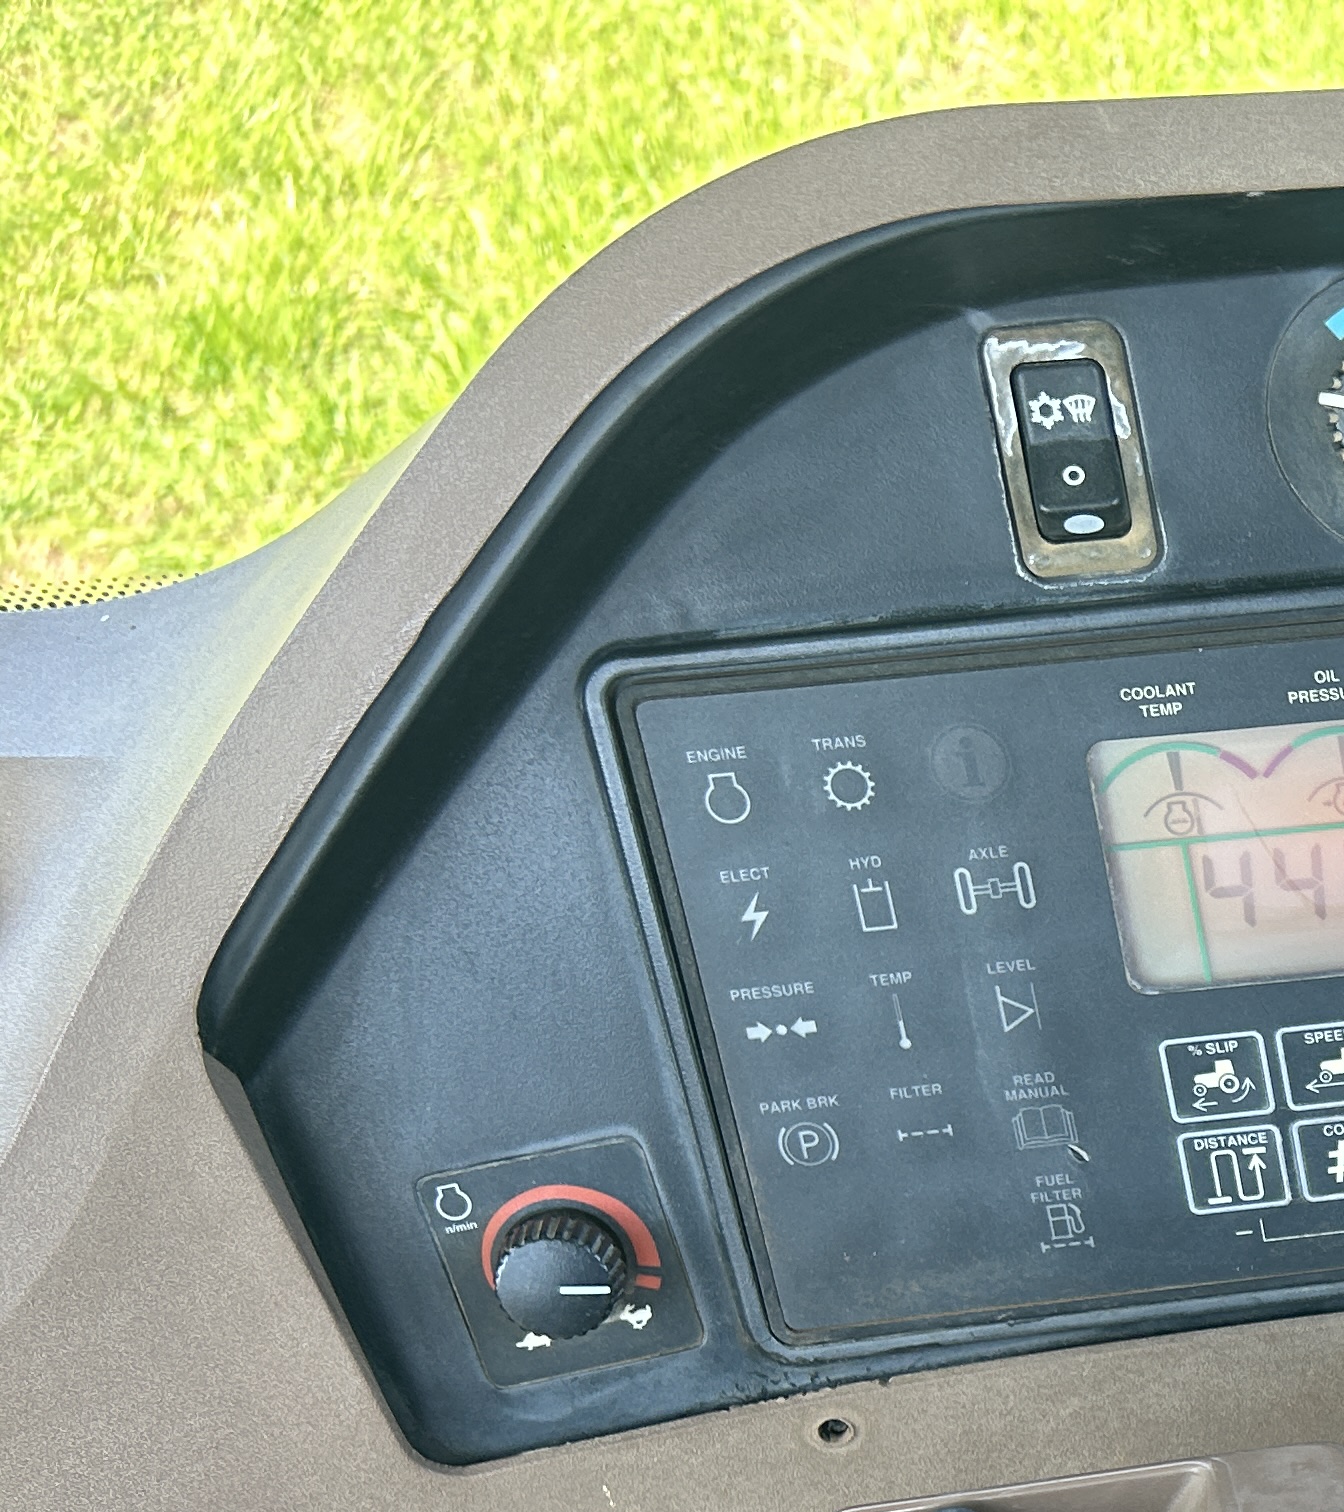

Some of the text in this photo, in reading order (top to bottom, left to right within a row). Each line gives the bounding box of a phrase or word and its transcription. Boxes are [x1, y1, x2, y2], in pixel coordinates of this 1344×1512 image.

[1314, 670, 1340, 683] OIL
[1120, 682, 1195, 700] COOLANT
[1139, 702, 1182, 717] TEMP
[811, 735, 866, 750] TRANS
[686, 746, 746, 763] ENGINE
[969, 846, 1008, 860] AXLE
[849, 856, 881, 869] HYD
[720, 867, 769, 883] ELECT
[986, 960, 1035, 974] LEVEL
[869, 972, 911, 986] TEMP
[730, 982, 814, 1001] PRESSURE
[1205, 1040, 1238, 1054] SLIP
[1013, 1072, 1054, 1086] READ
[890, 1084, 942, 1099] FILTER
[1005, 1085, 1069, 1101] MANUAL
[760, 1095, 838, 1114] PARK BRK
[1193, 1131, 1269, 1151] DISTANCE
[1035, 1173, 1075, 1188] FUEL
[1030, 1187, 1083, 1204] FILTER
[445, 1222, 478, 1234] n/min
